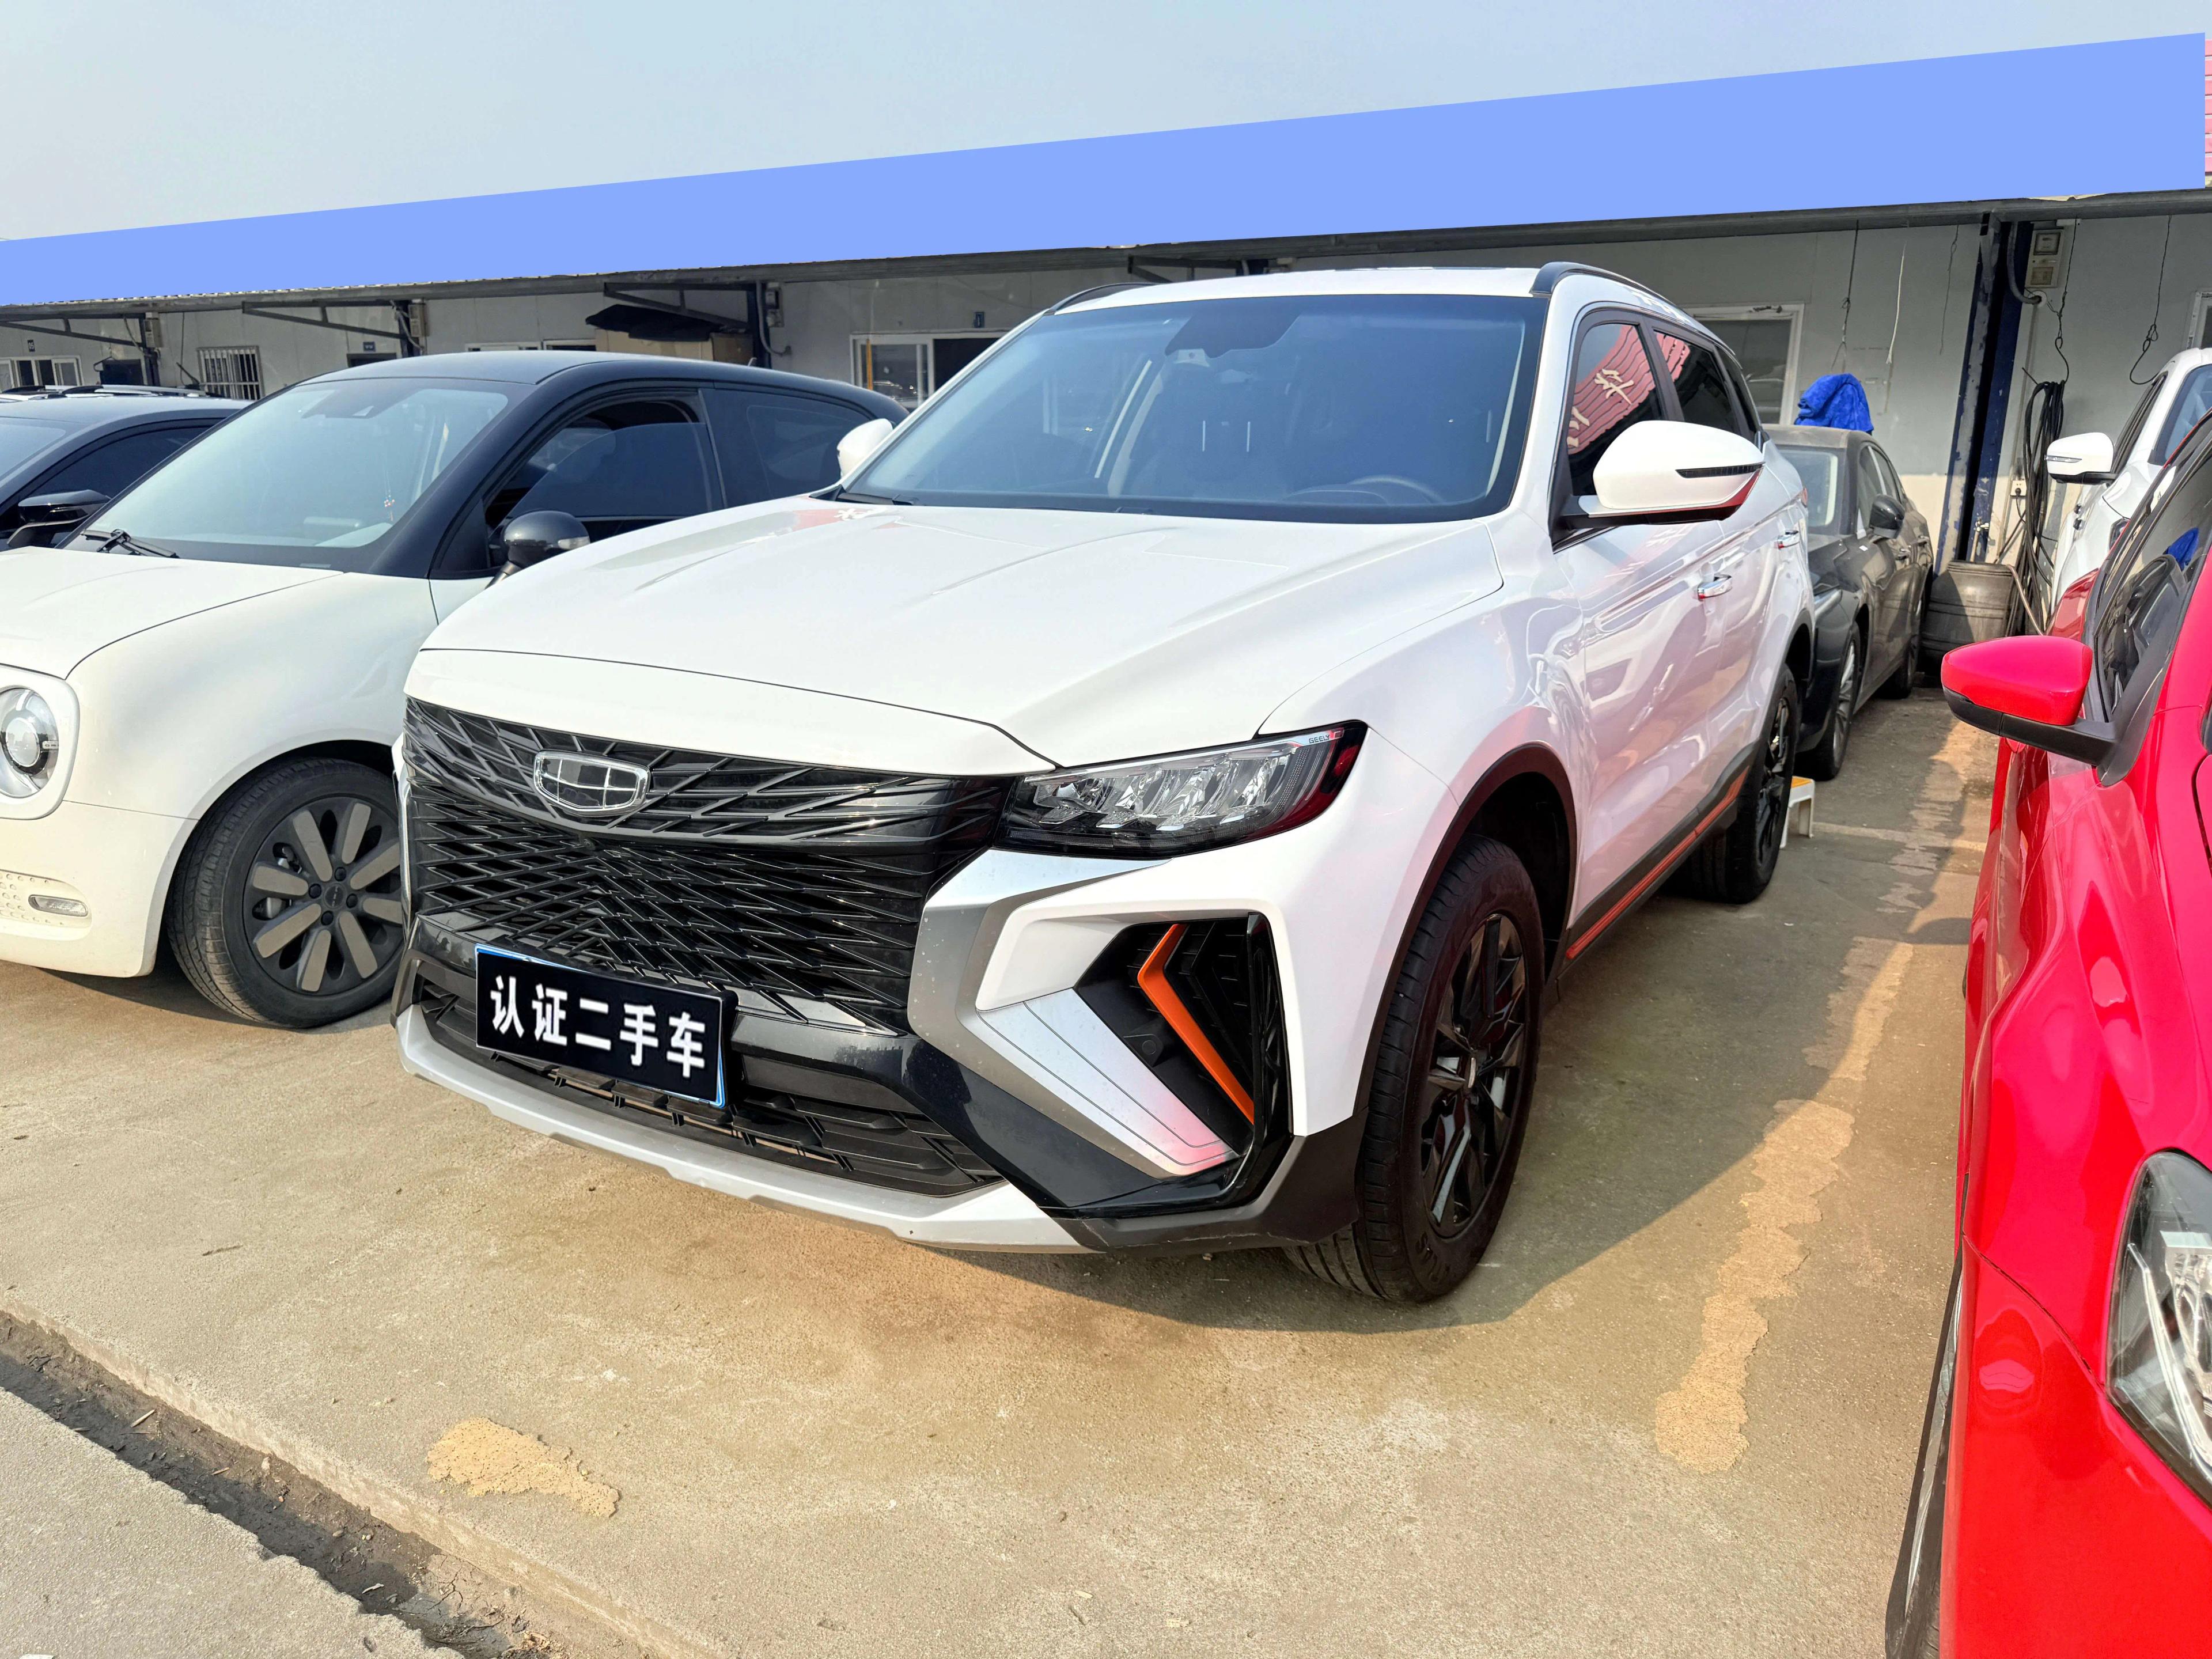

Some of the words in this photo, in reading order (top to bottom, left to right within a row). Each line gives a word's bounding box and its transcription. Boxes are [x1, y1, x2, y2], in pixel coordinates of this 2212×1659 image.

[1309, 734, 1330, 744] GEELY
[490, 975, 706, 1078] 认证二手车
